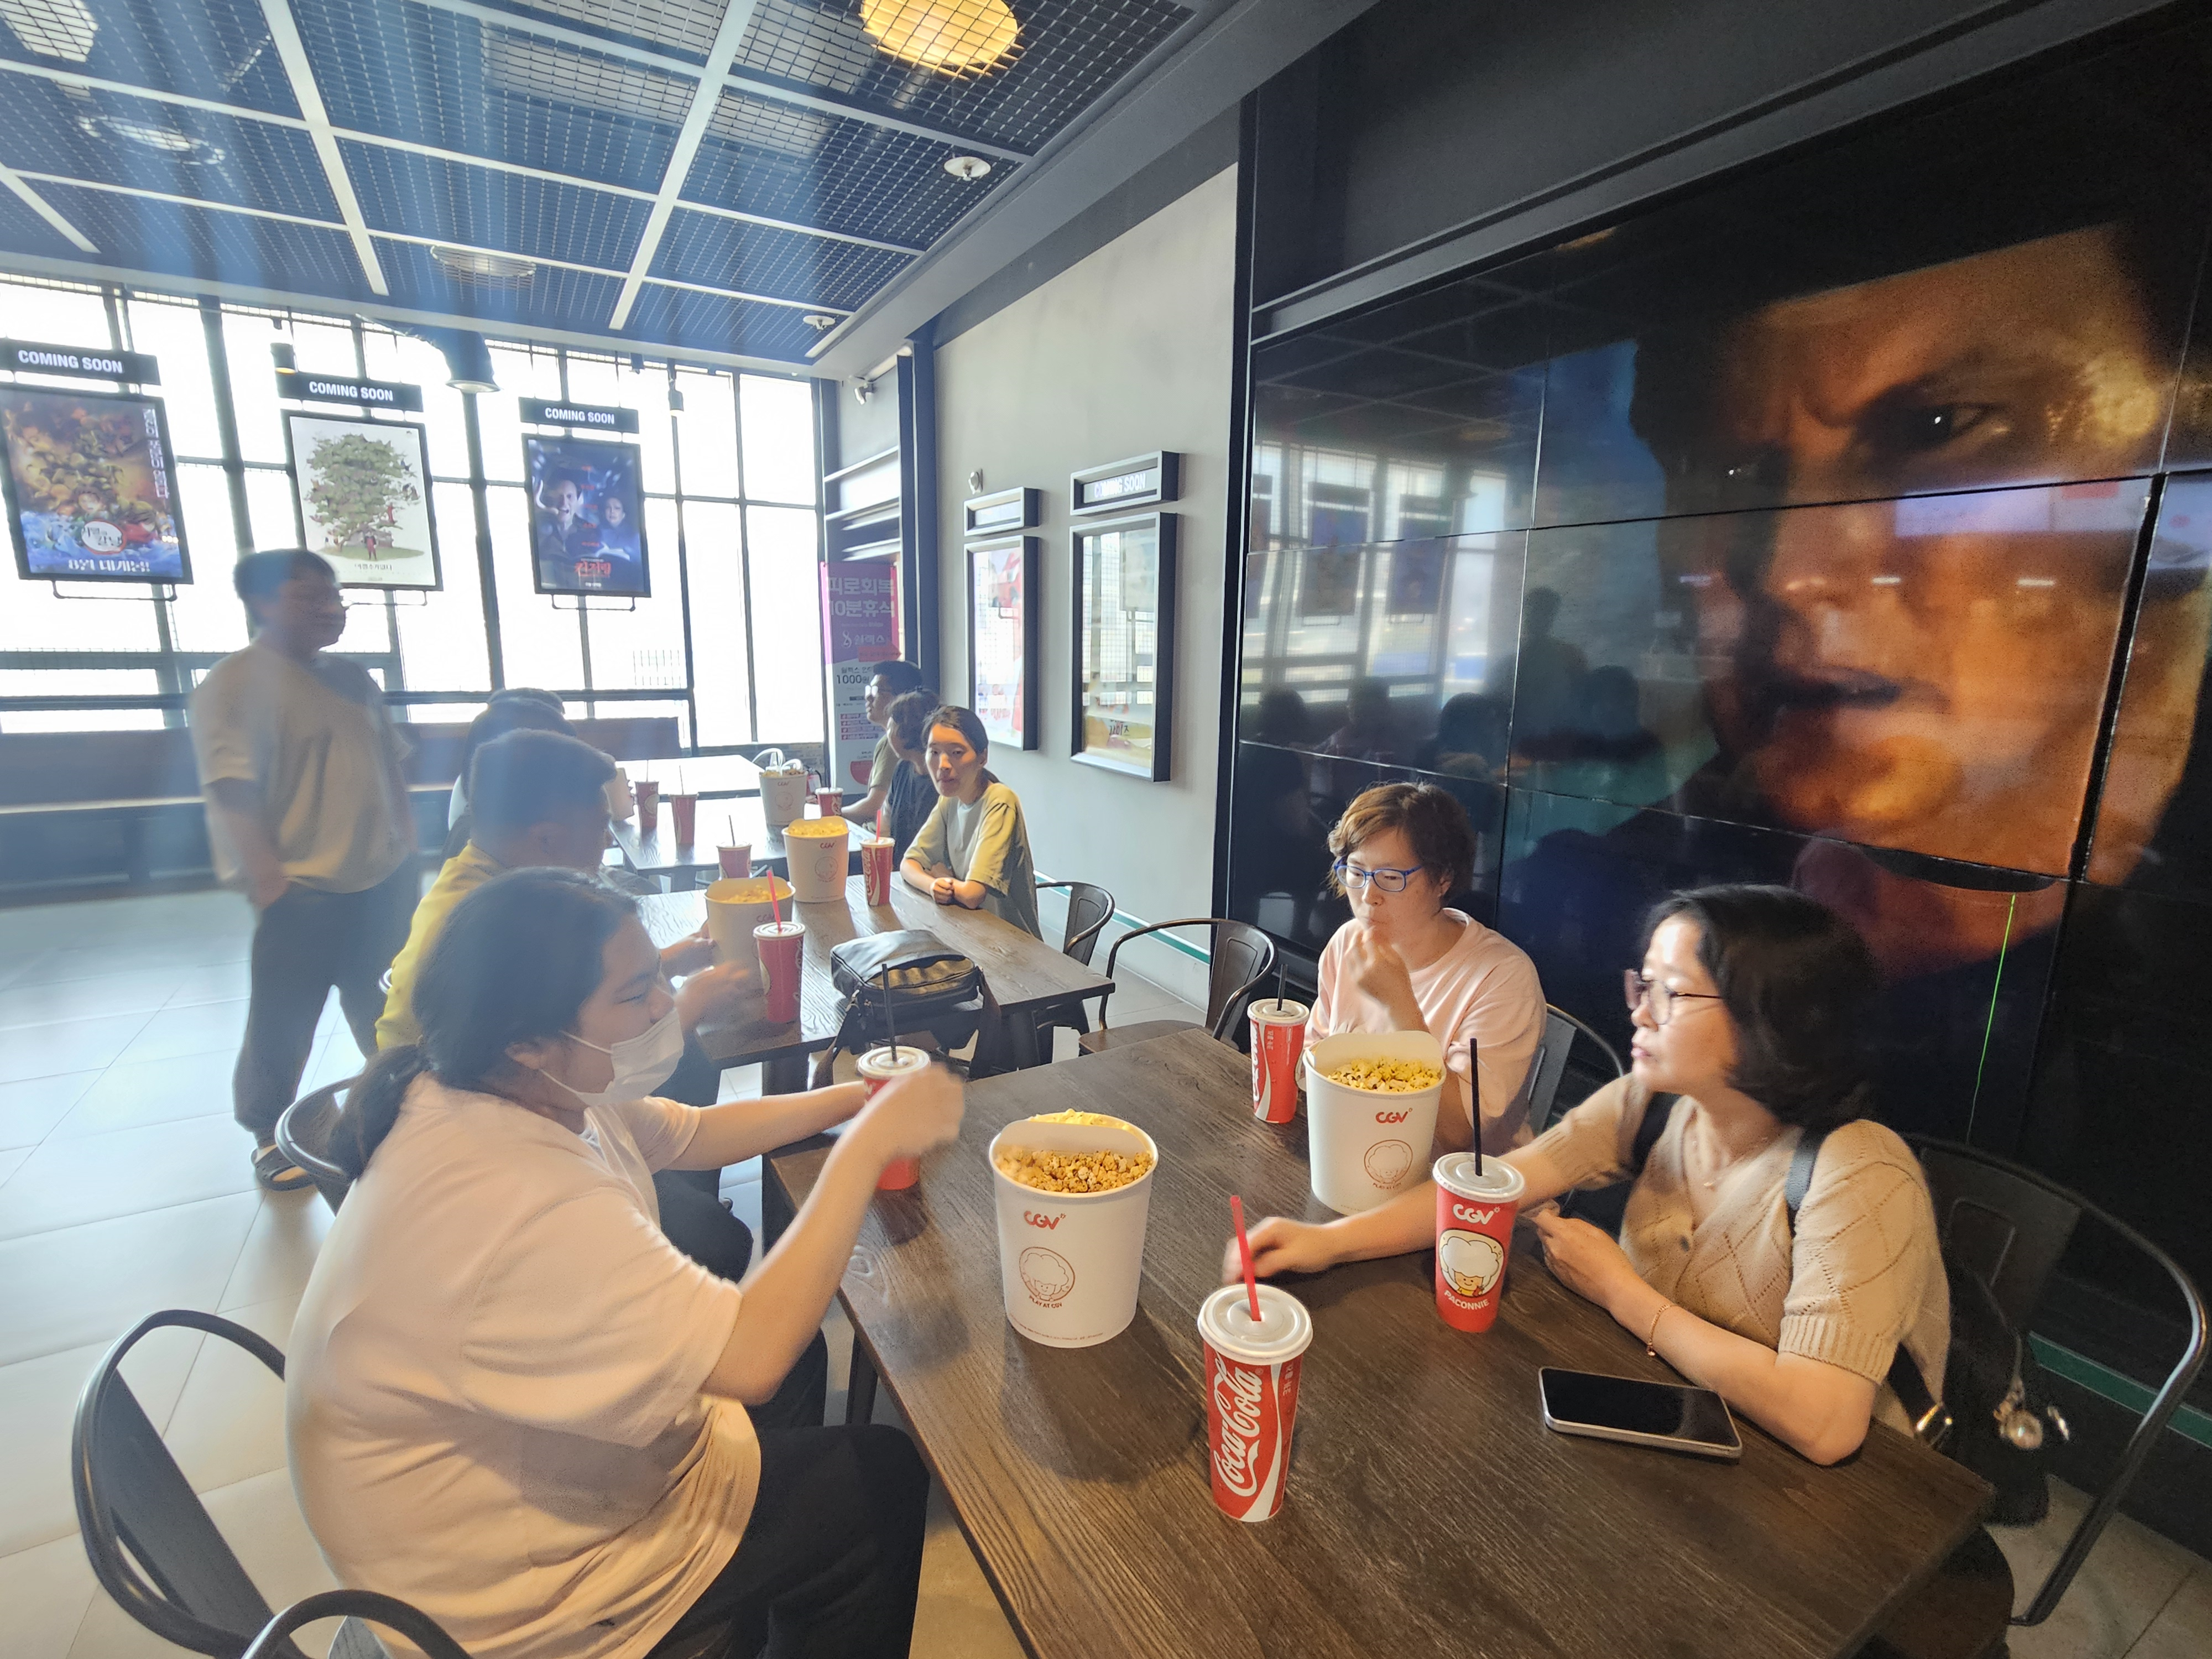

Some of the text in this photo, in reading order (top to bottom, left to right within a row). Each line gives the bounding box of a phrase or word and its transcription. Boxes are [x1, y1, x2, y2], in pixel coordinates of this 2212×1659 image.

[18, 349, 123, 374] COMING SOON
[309, 381, 394, 401] COMING SOON
[545, 407, 615, 425] COMING SOON
[1124, 473, 1146, 492] SOON
[827, 577, 894, 597] 피로회복
[1375, 1112, 1408, 1124] CGV
[1024, 1211, 1060, 1230] CGV
[1452, 1203, 1494, 1225] CGV
[1444, 1289, 1490, 1311] PACONNIE
[1213, 1351, 1262, 1497] Coca-Cola
